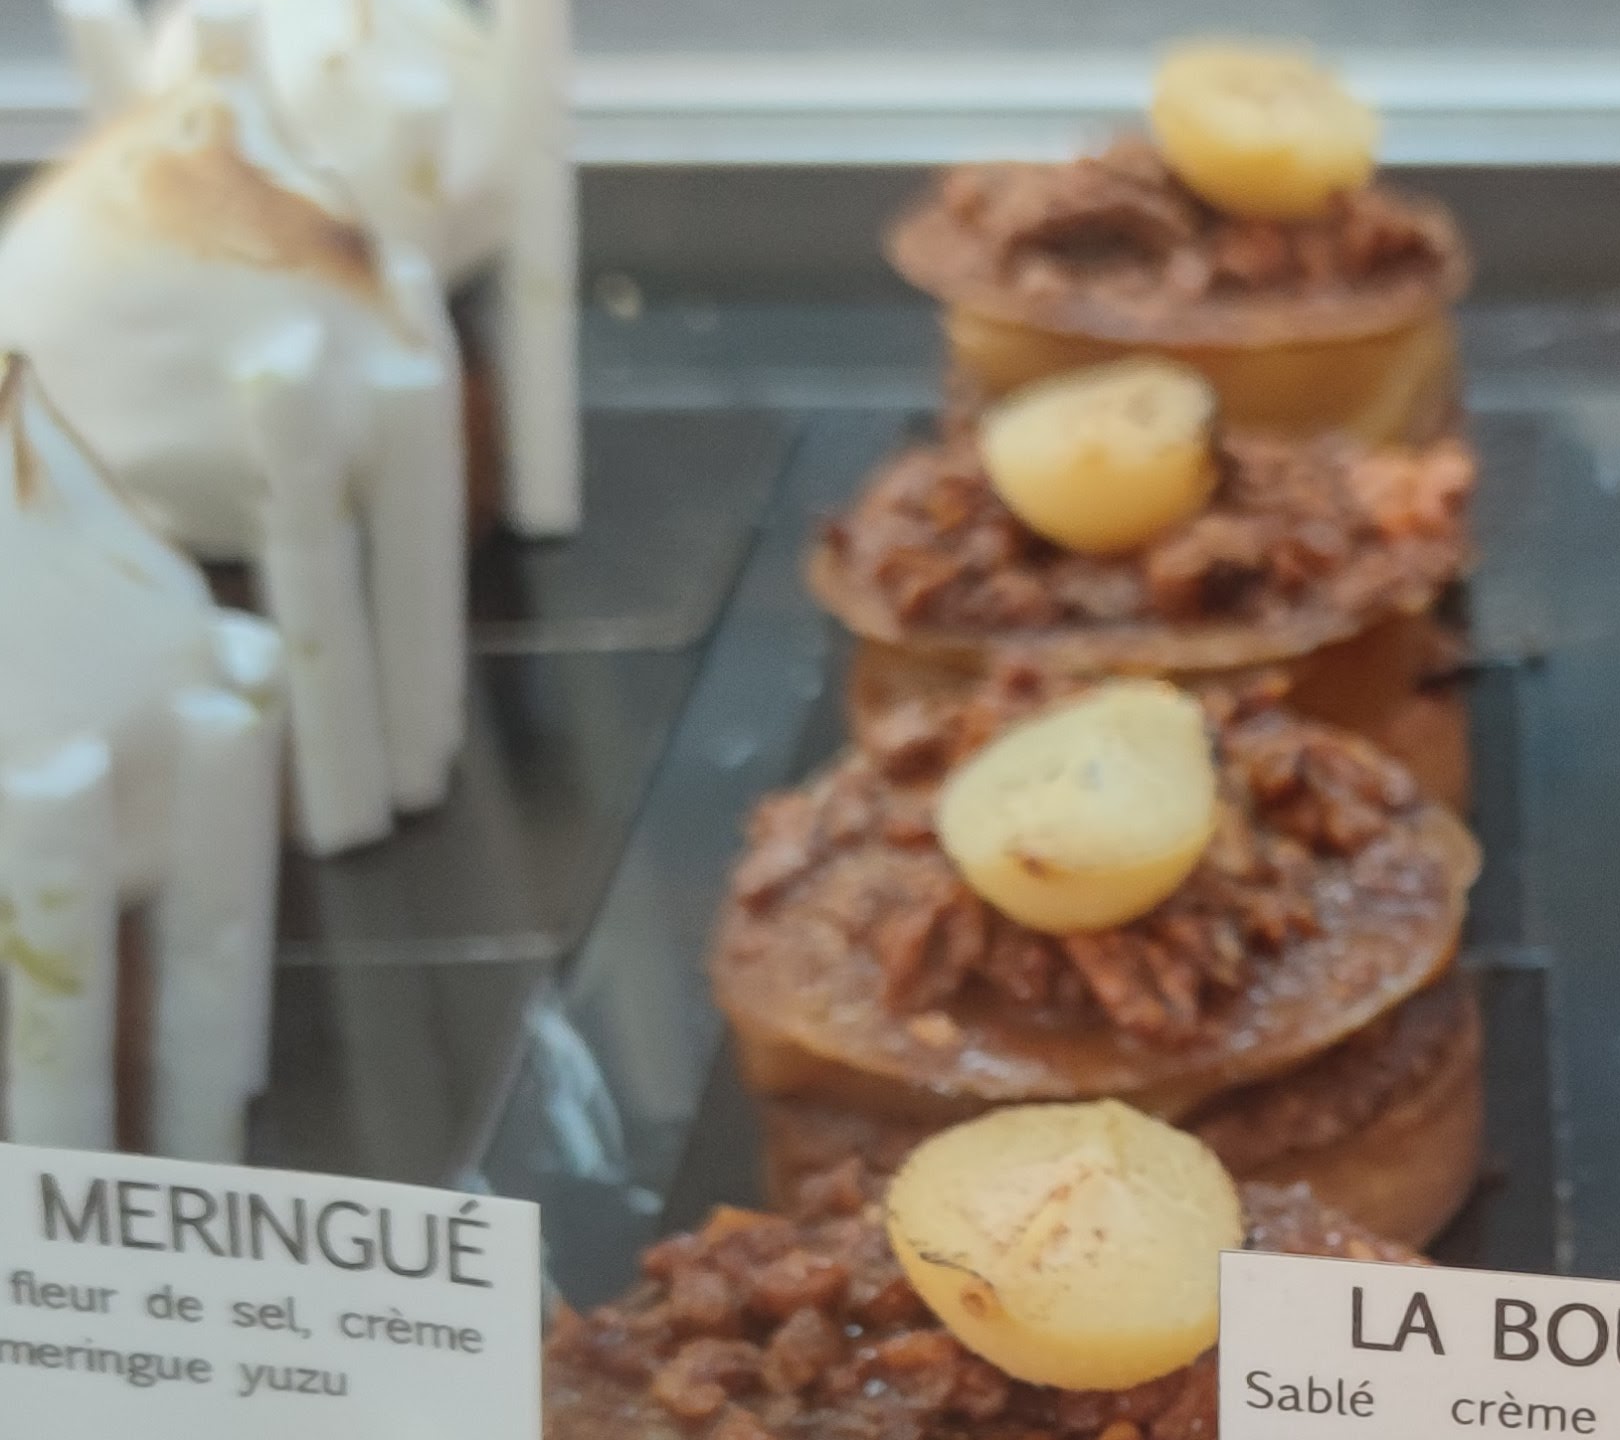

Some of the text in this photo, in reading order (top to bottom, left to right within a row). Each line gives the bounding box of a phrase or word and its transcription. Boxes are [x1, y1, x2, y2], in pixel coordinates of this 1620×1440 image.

[41, 1172, 493, 1288] MERINGUÉ
[7, 1269, 483, 1355] fleur de sel, crème
[1351, 1286, 1446, 1356] LA
[0, 1338, 348, 1398] meringue yuzu
[1246, 1370, 1374, 1418] Sablé
[1451, 1390, 1597, 1435] crème
